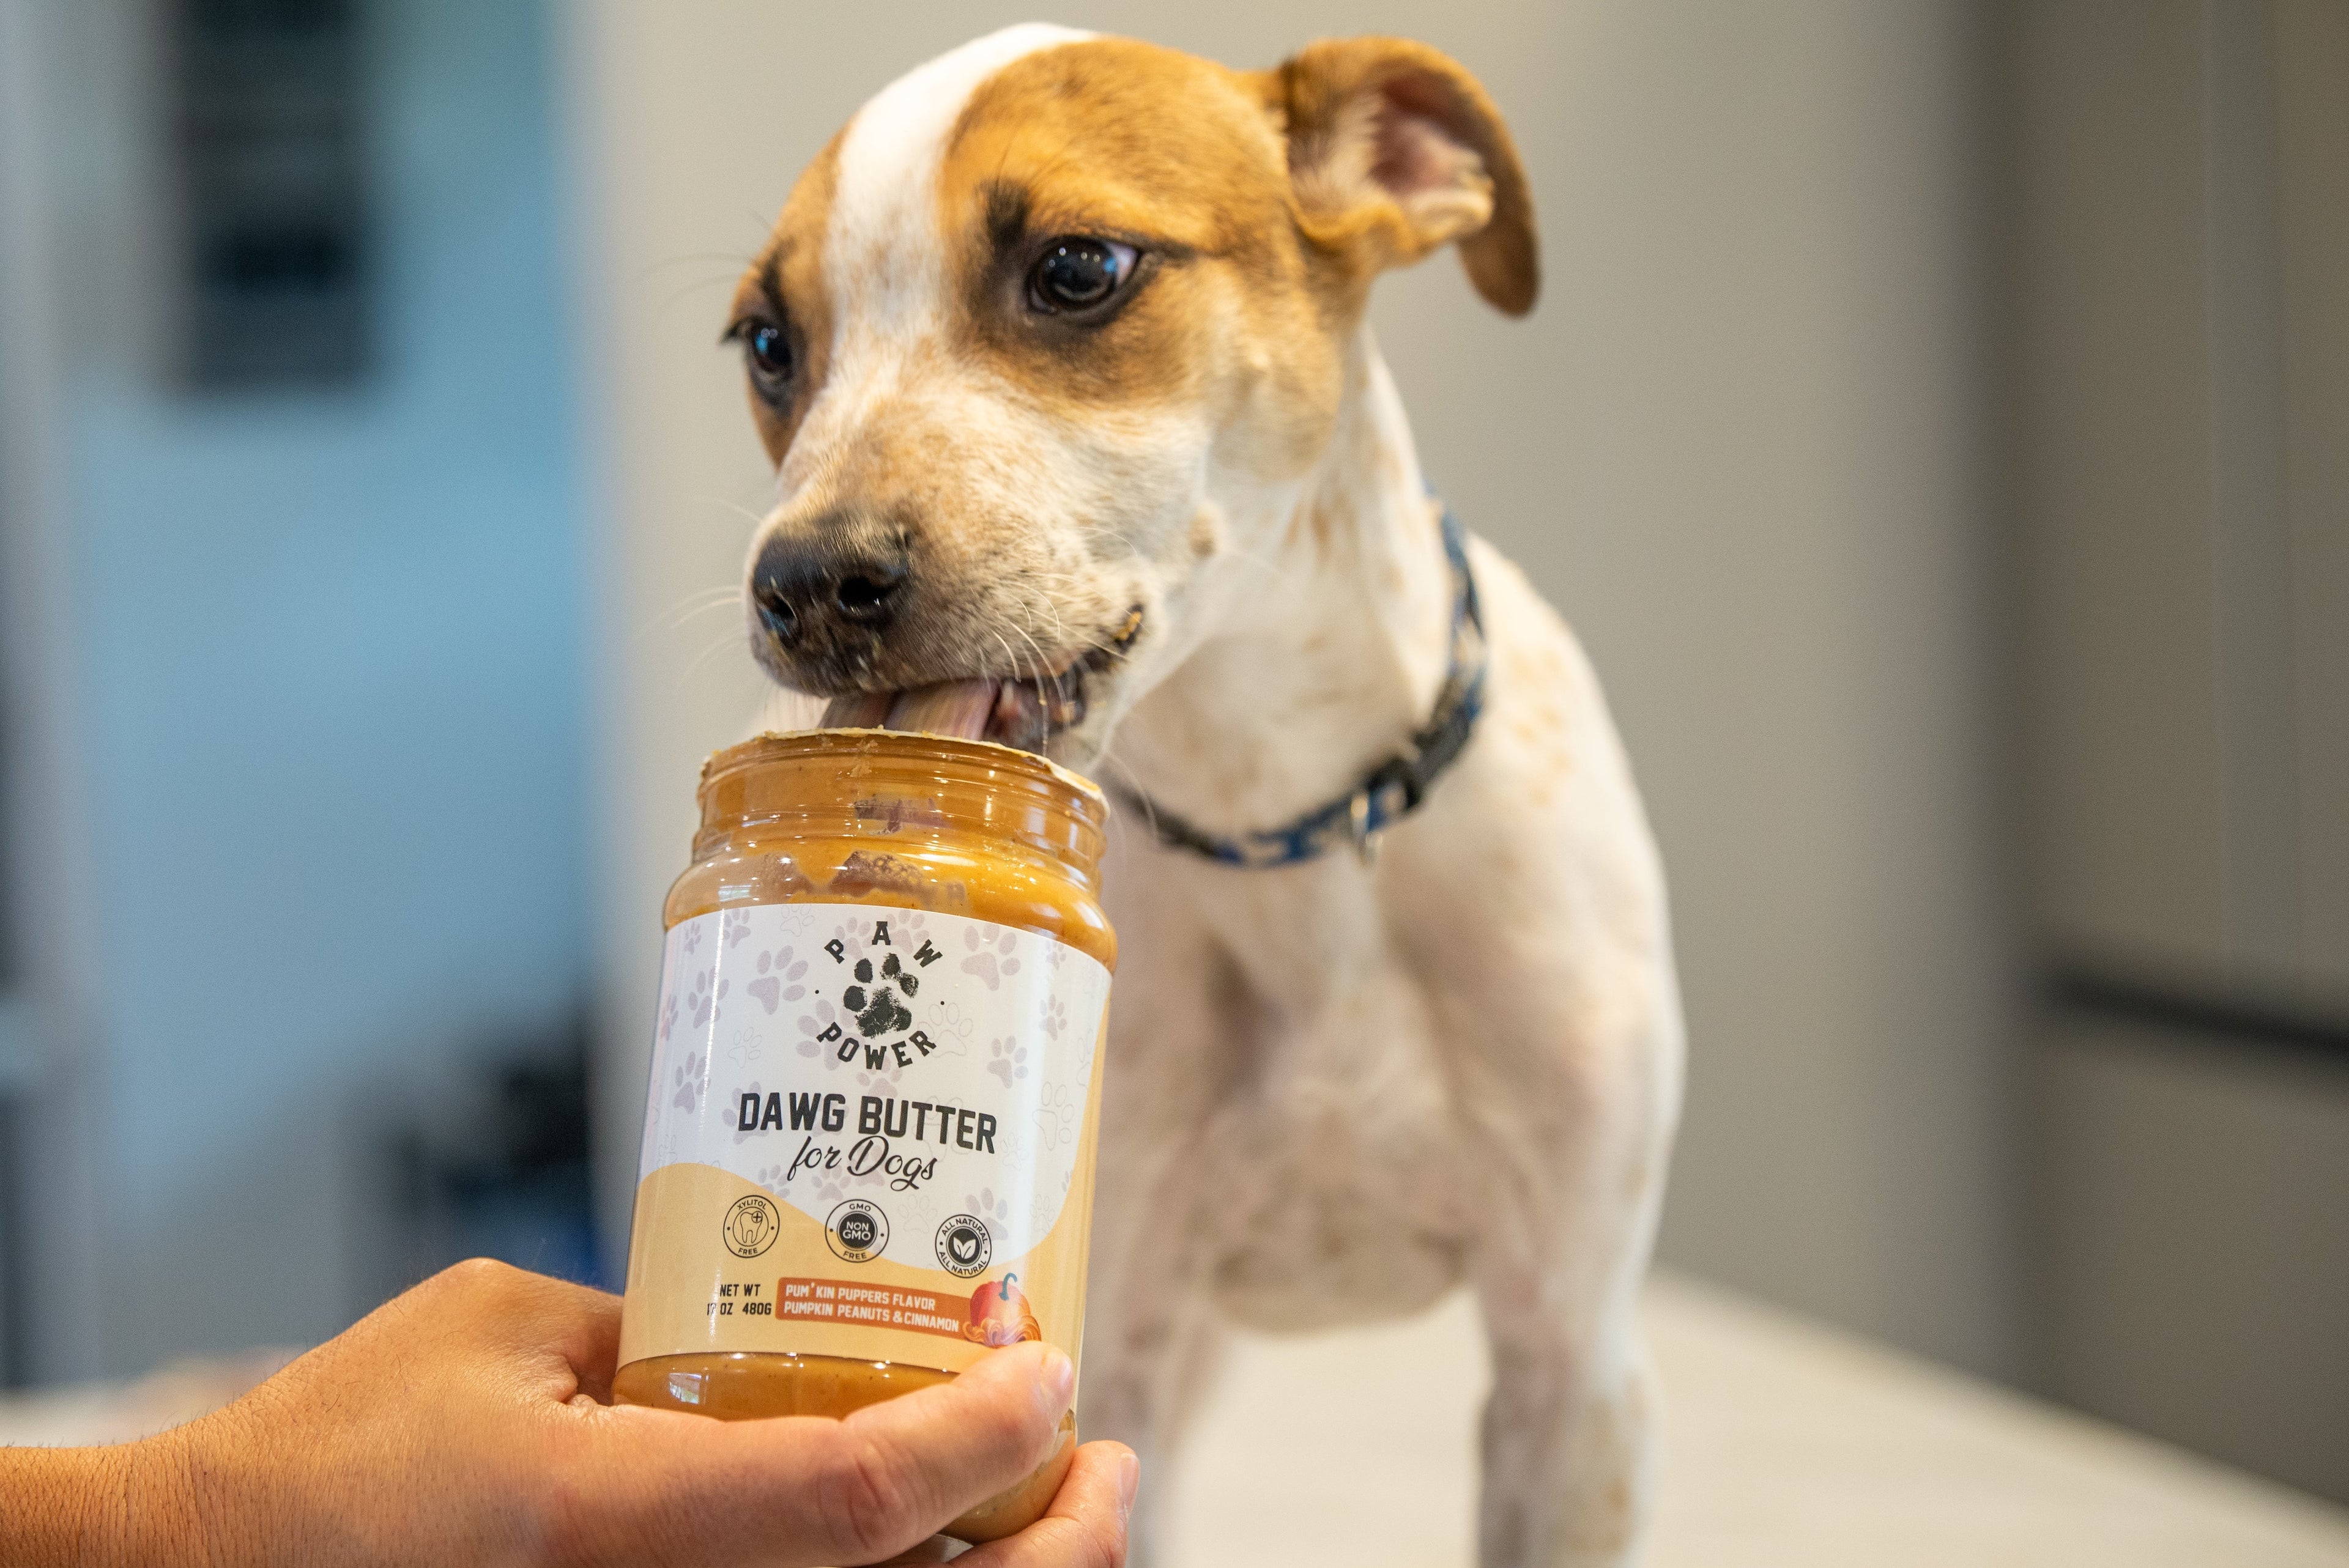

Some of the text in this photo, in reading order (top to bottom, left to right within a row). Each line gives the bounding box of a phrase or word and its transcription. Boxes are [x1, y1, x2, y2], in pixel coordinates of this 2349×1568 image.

[824, 921, 943, 967] PAW
[816, 1021, 937, 1070] POWER
[738, 1092, 997, 1154] DAWG BUTTER
[787, 1135, 938, 1192] for Dogs
[737, 1199, 768, 1210] XYLITOL
[848, 1203, 871, 1212] GMO
[846, 1221, 869, 1231] NON
[941, 1218, 989, 1244] ALL NATURAL
[842, 1230, 871, 1241] GMO
[738, 1247, 759, 1256] FREE
[842, 1250, 867, 1260] FREE
[939, 1251, 987, 1276] ALL NATURAL
[719, 1284, 760, 1296] NET WT
[837, 1289, 890, 1304] PUPPERS
[892, 1294, 937, 1311] FLAVOR
[720, 1303, 733, 1315] OZ
[742, 1303, 772, 1315] 480G
[784, 1301, 833, 1317] PUMPKIN
[837, 1304, 889, 1322] PEANUTS
